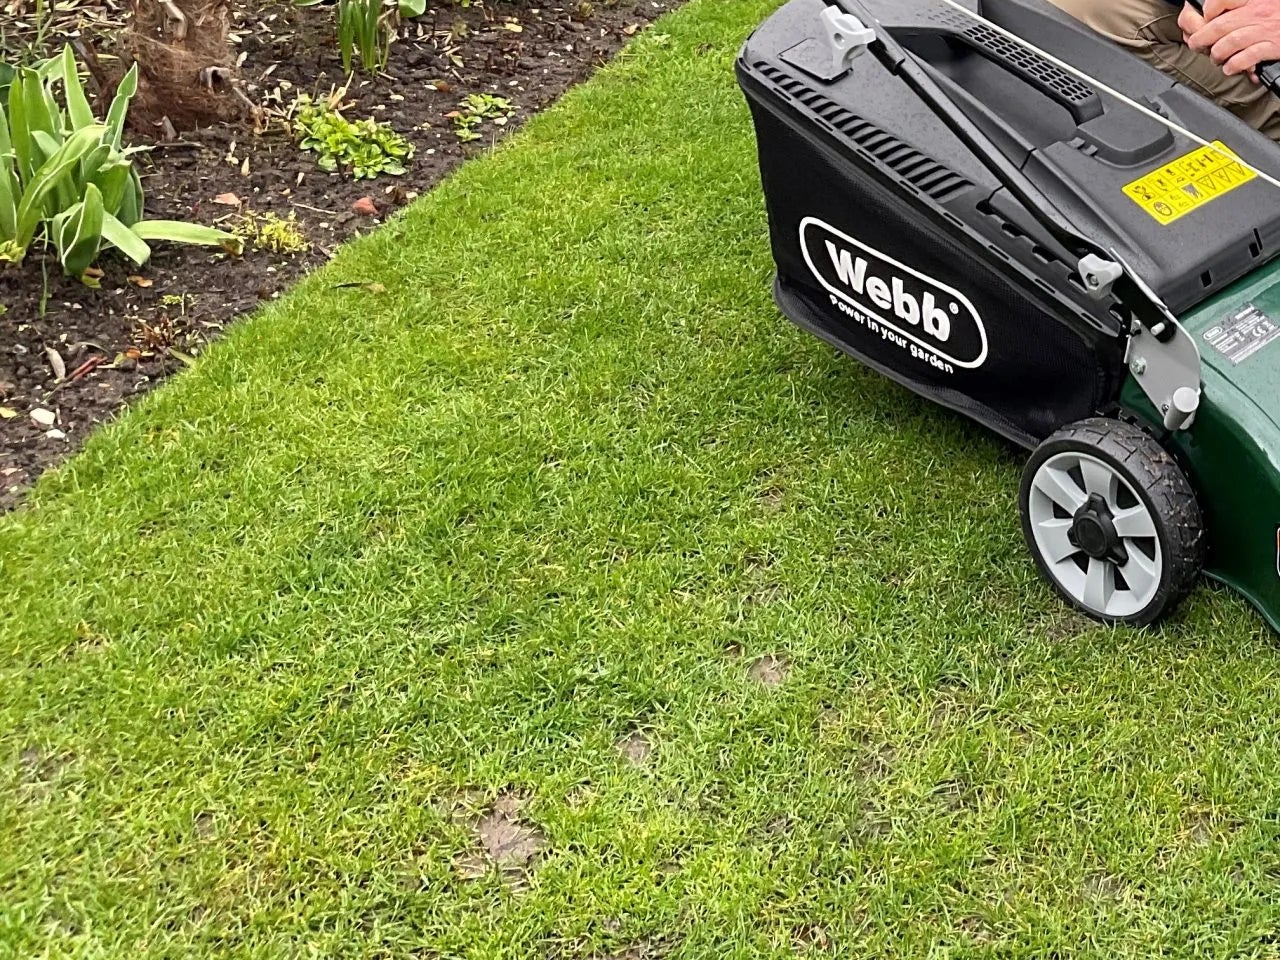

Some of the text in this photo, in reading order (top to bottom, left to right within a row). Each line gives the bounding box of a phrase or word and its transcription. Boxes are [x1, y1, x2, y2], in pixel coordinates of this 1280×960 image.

[829, 294, 954, 374] Power in your garden
